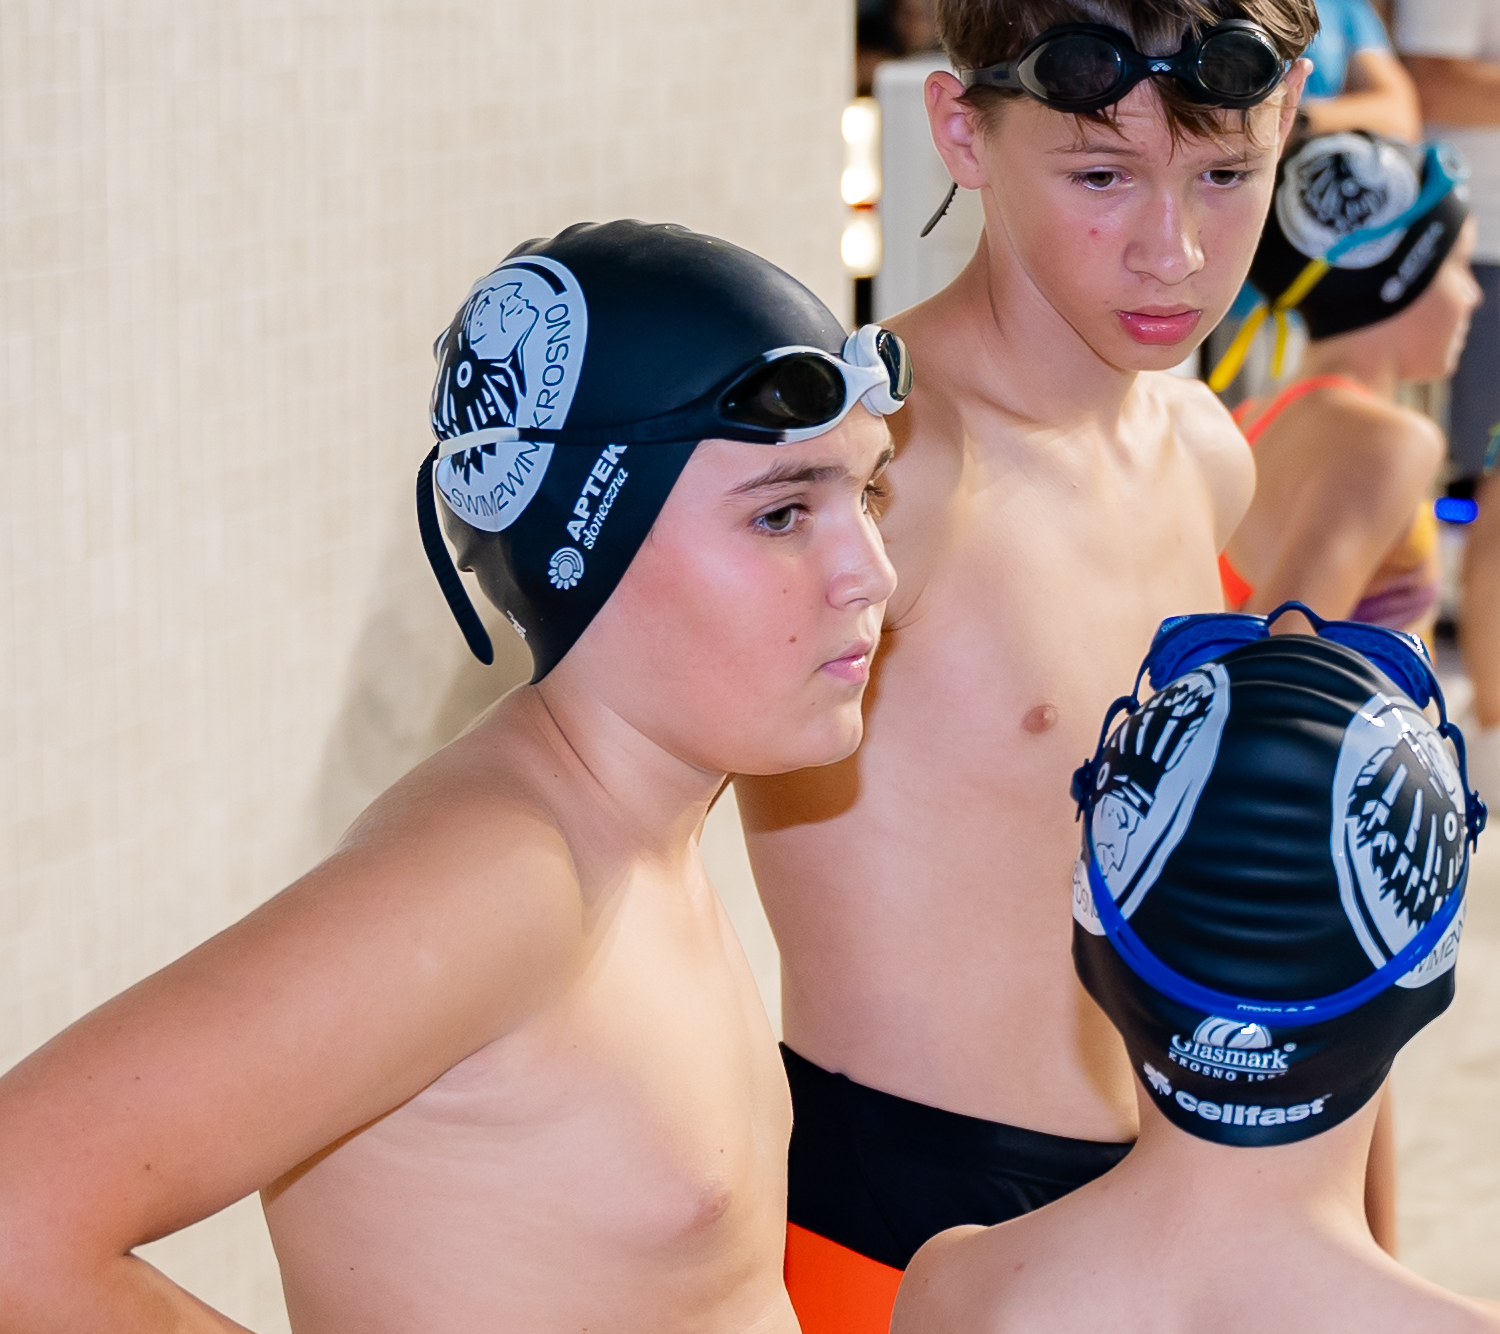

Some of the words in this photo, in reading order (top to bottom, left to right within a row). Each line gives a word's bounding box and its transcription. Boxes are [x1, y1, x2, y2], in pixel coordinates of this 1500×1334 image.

[532, 303, 571, 429] KROSNO
[566, 444, 629, 542] APTEK
[1168, 1051, 1237, 1082] KROSNO
[1171, 1034, 1289, 1069] Glasmark
[1175, 1090, 1326, 1127] cellfast
